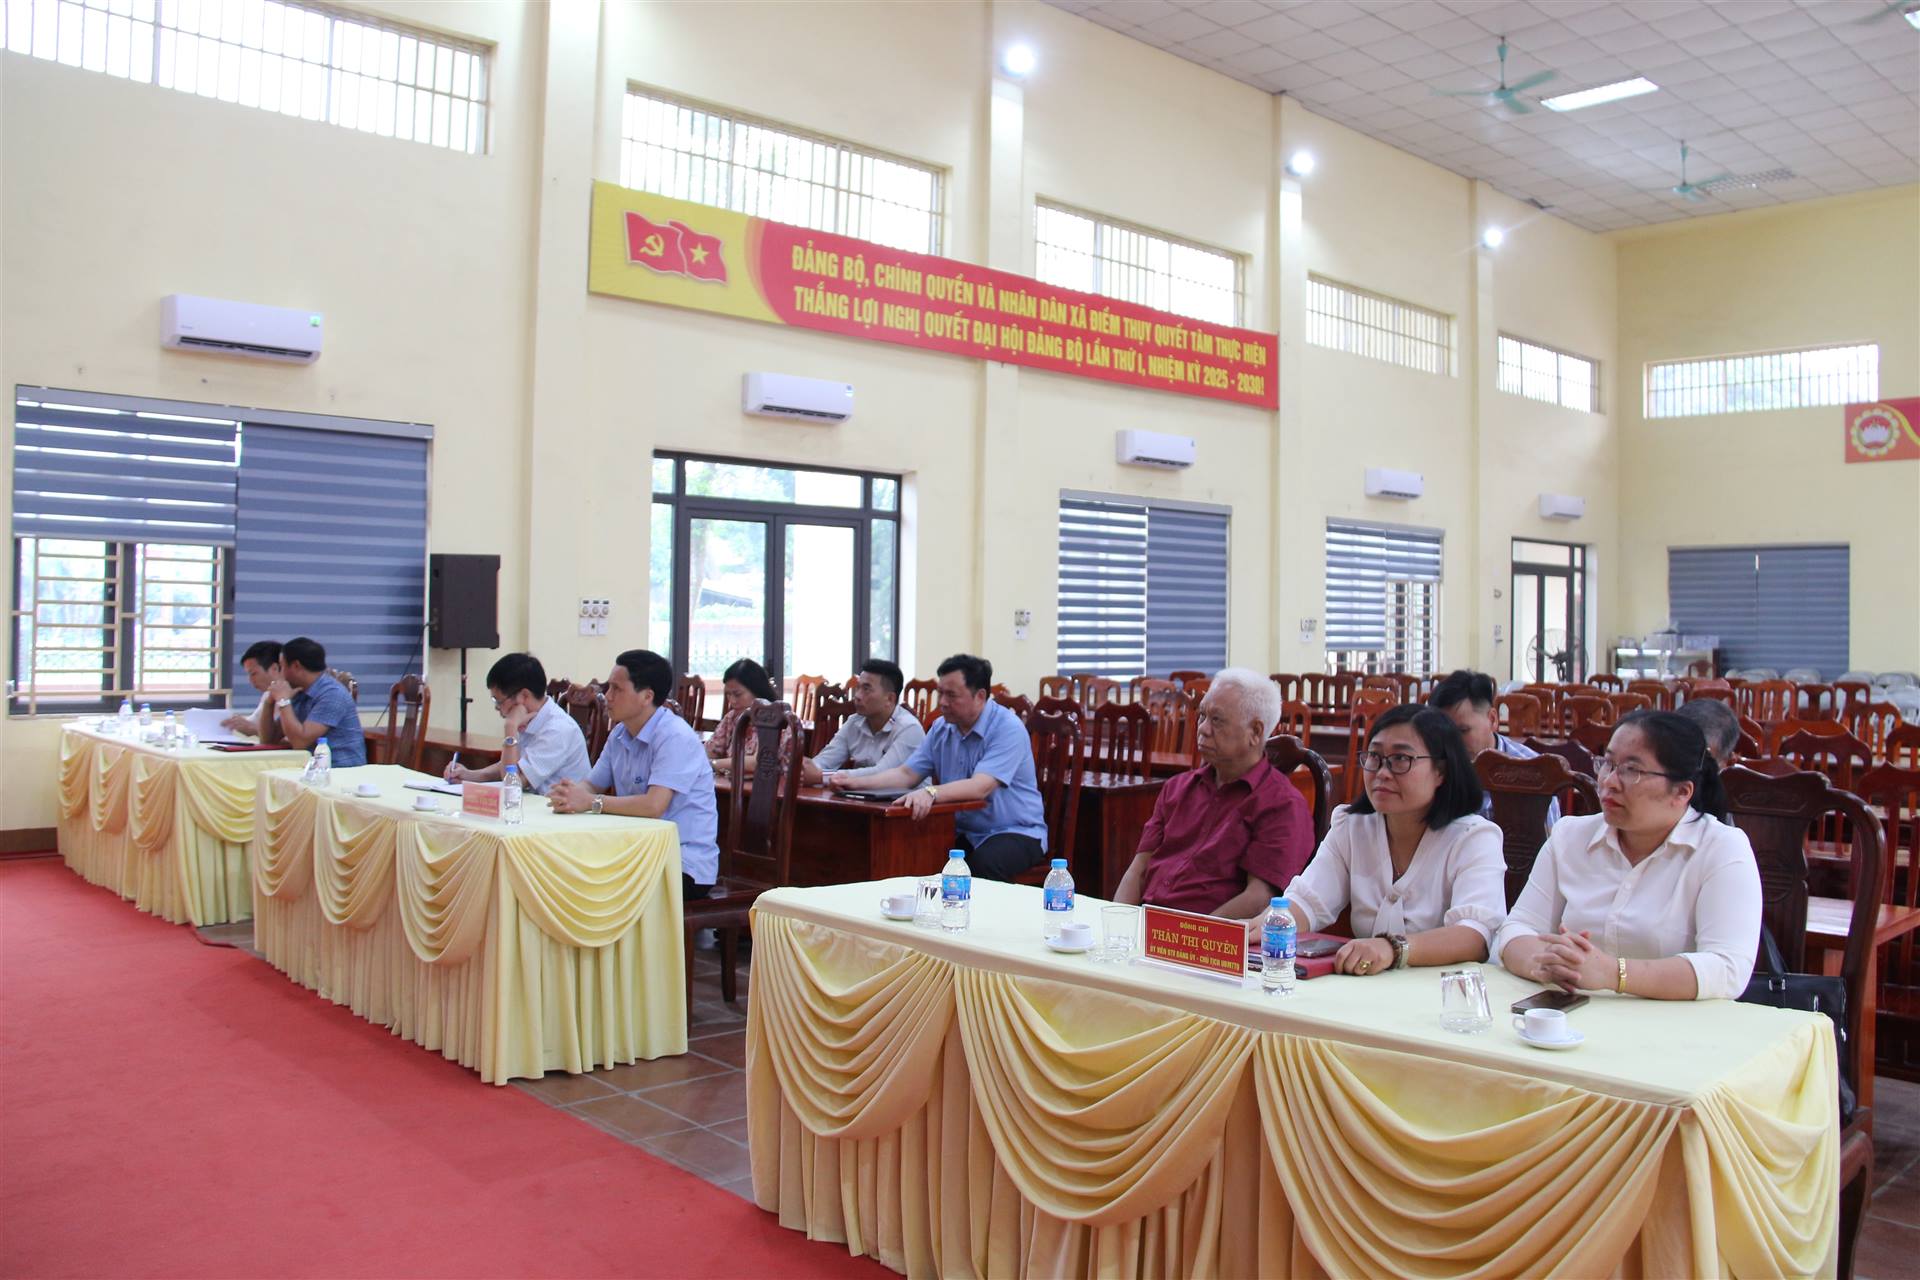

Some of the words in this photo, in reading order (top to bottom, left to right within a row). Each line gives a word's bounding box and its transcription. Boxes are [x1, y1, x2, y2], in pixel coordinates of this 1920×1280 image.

[792, 240, 838, 279] ĐẢNG
[843, 254, 870, 289] BỘ,
[874, 262, 922, 295] CHÍNH
[926, 273, 974, 306] QUYỀN
[977, 282, 996, 310] VÀ
[999, 289, 1037, 319] NHÂN
[1040, 296, 1067, 325] DÂN
[1070, 303, 1087, 329] XÃ
[1123, 317, 1151, 345] THỤY
[1154, 322, 1188, 349] QUYẾT
[1190, 328, 1213, 354] TÂM
[1215, 336, 1241, 364] THỰC
[1243, 341, 1266, 368] HIỆN
[794, 281, 849, 319] THẮNG
[853, 297, 879, 329] LỢI
[883, 303, 920, 338] NGHỊ
[925, 311, 969, 343] QUYẾT
[973, 320, 996, 350] ĐẠI
[1001, 323, 1024, 355] HỘI
[1027, 326, 1062, 358] ĐẢNG
[1066, 336, 1083, 367] BỘ
[1086, 337, 1110, 367] LẦN
[1113, 346, 1136, 372] THỨ
[1148, 355, 1184, 383] NHIỆM
[1187, 360, 1201, 385] KỲ
[1203, 366, 1228, 389] 2025
[1237, 373, 1265, 396] 2030!
[1181, 934, 1199, 950] THỊ
